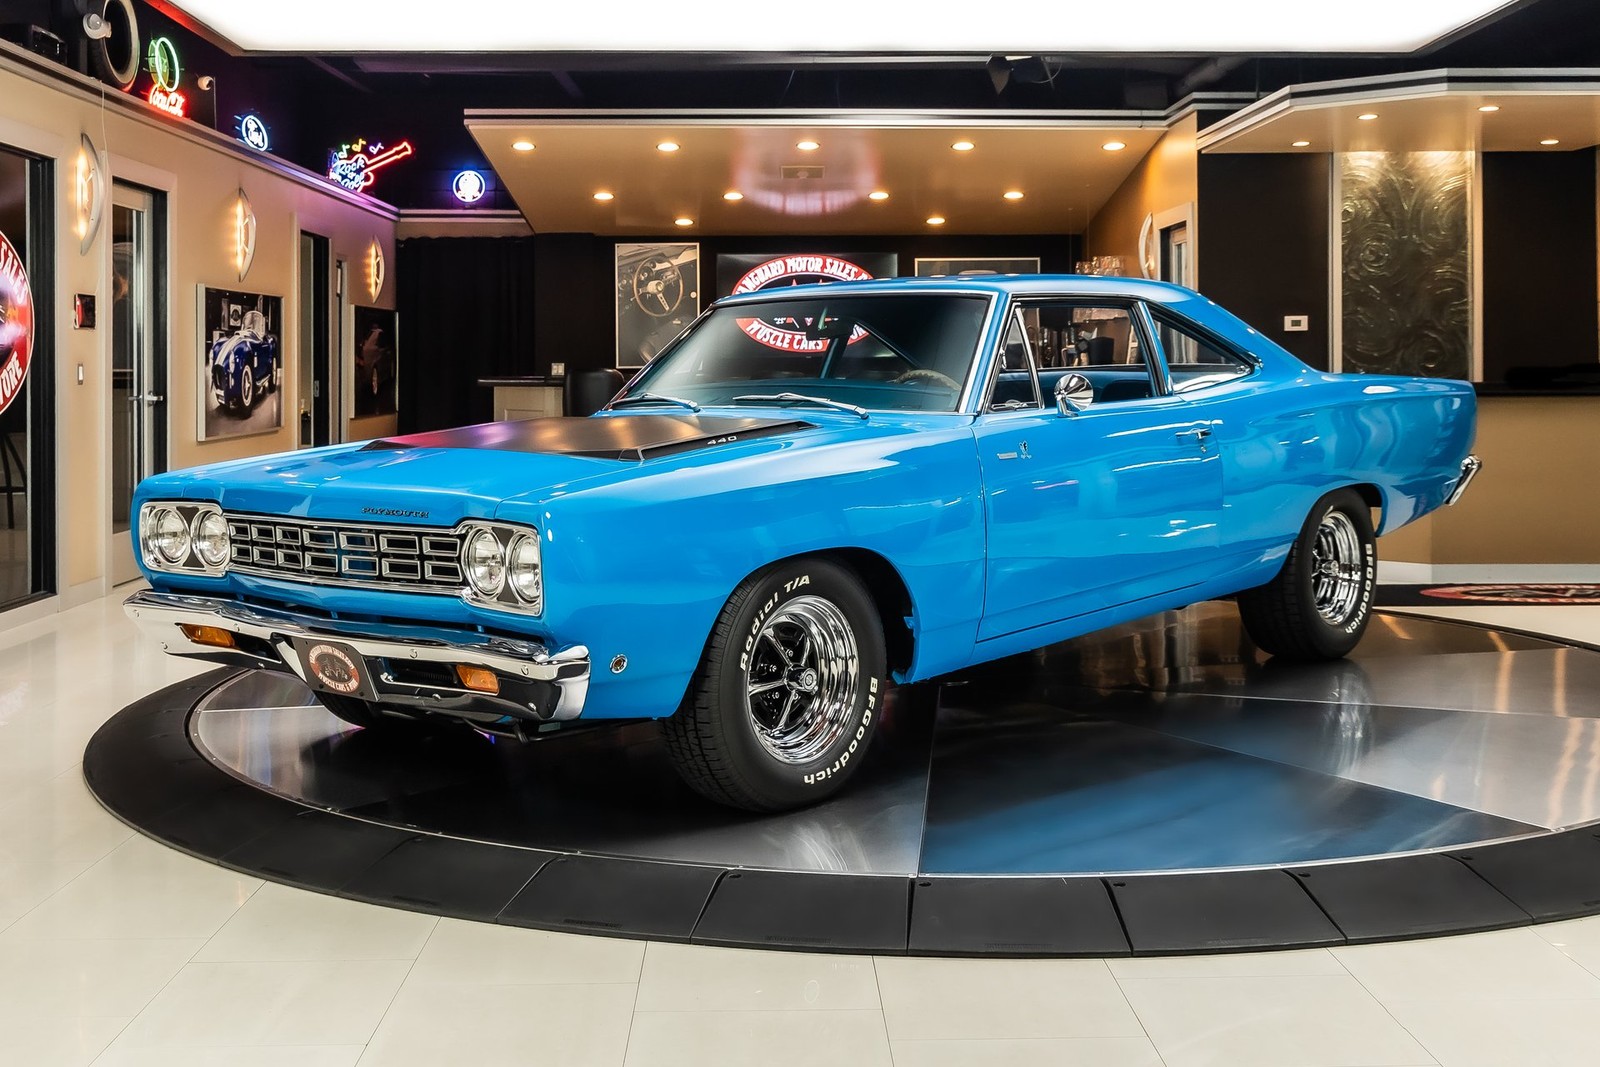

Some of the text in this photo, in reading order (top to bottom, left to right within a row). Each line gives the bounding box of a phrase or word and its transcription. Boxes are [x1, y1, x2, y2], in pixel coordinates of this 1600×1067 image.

[786, 257, 823, 273] MOTOR
[746, 320, 791, 349] MUSCLE
[0, 350, 23, 405] ORE
[707, 435, 738, 445] 440
[361, 506, 430, 519] PLYMOUTH
[740, 574, 810, 672] Radial T/A
[803, 677, 879, 785] BFGoodrich
